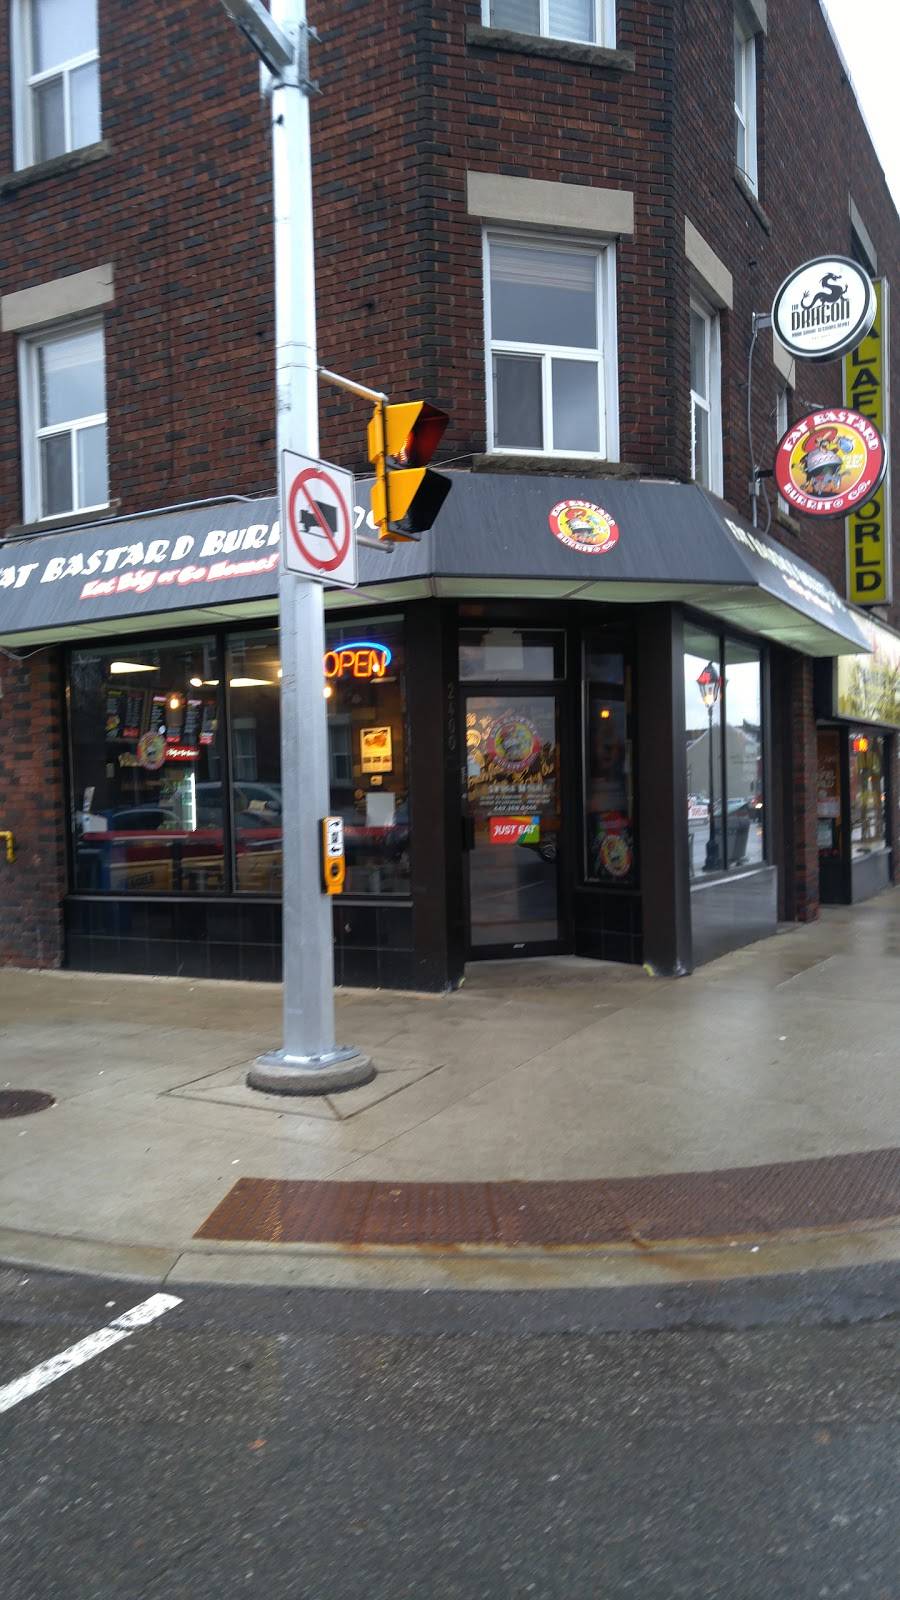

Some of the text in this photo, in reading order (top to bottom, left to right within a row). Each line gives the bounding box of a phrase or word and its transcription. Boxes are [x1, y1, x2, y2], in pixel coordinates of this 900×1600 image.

[783, 411, 879, 451] FAT BASTARD
[783, 483, 844, 510] BURRITO
[40, 535, 194, 584] BASTARD
[855, 500, 881, 592] ORLD
[322, 651, 386, 678] OPEN
[494, 824, 538, 838] JUST EAT
